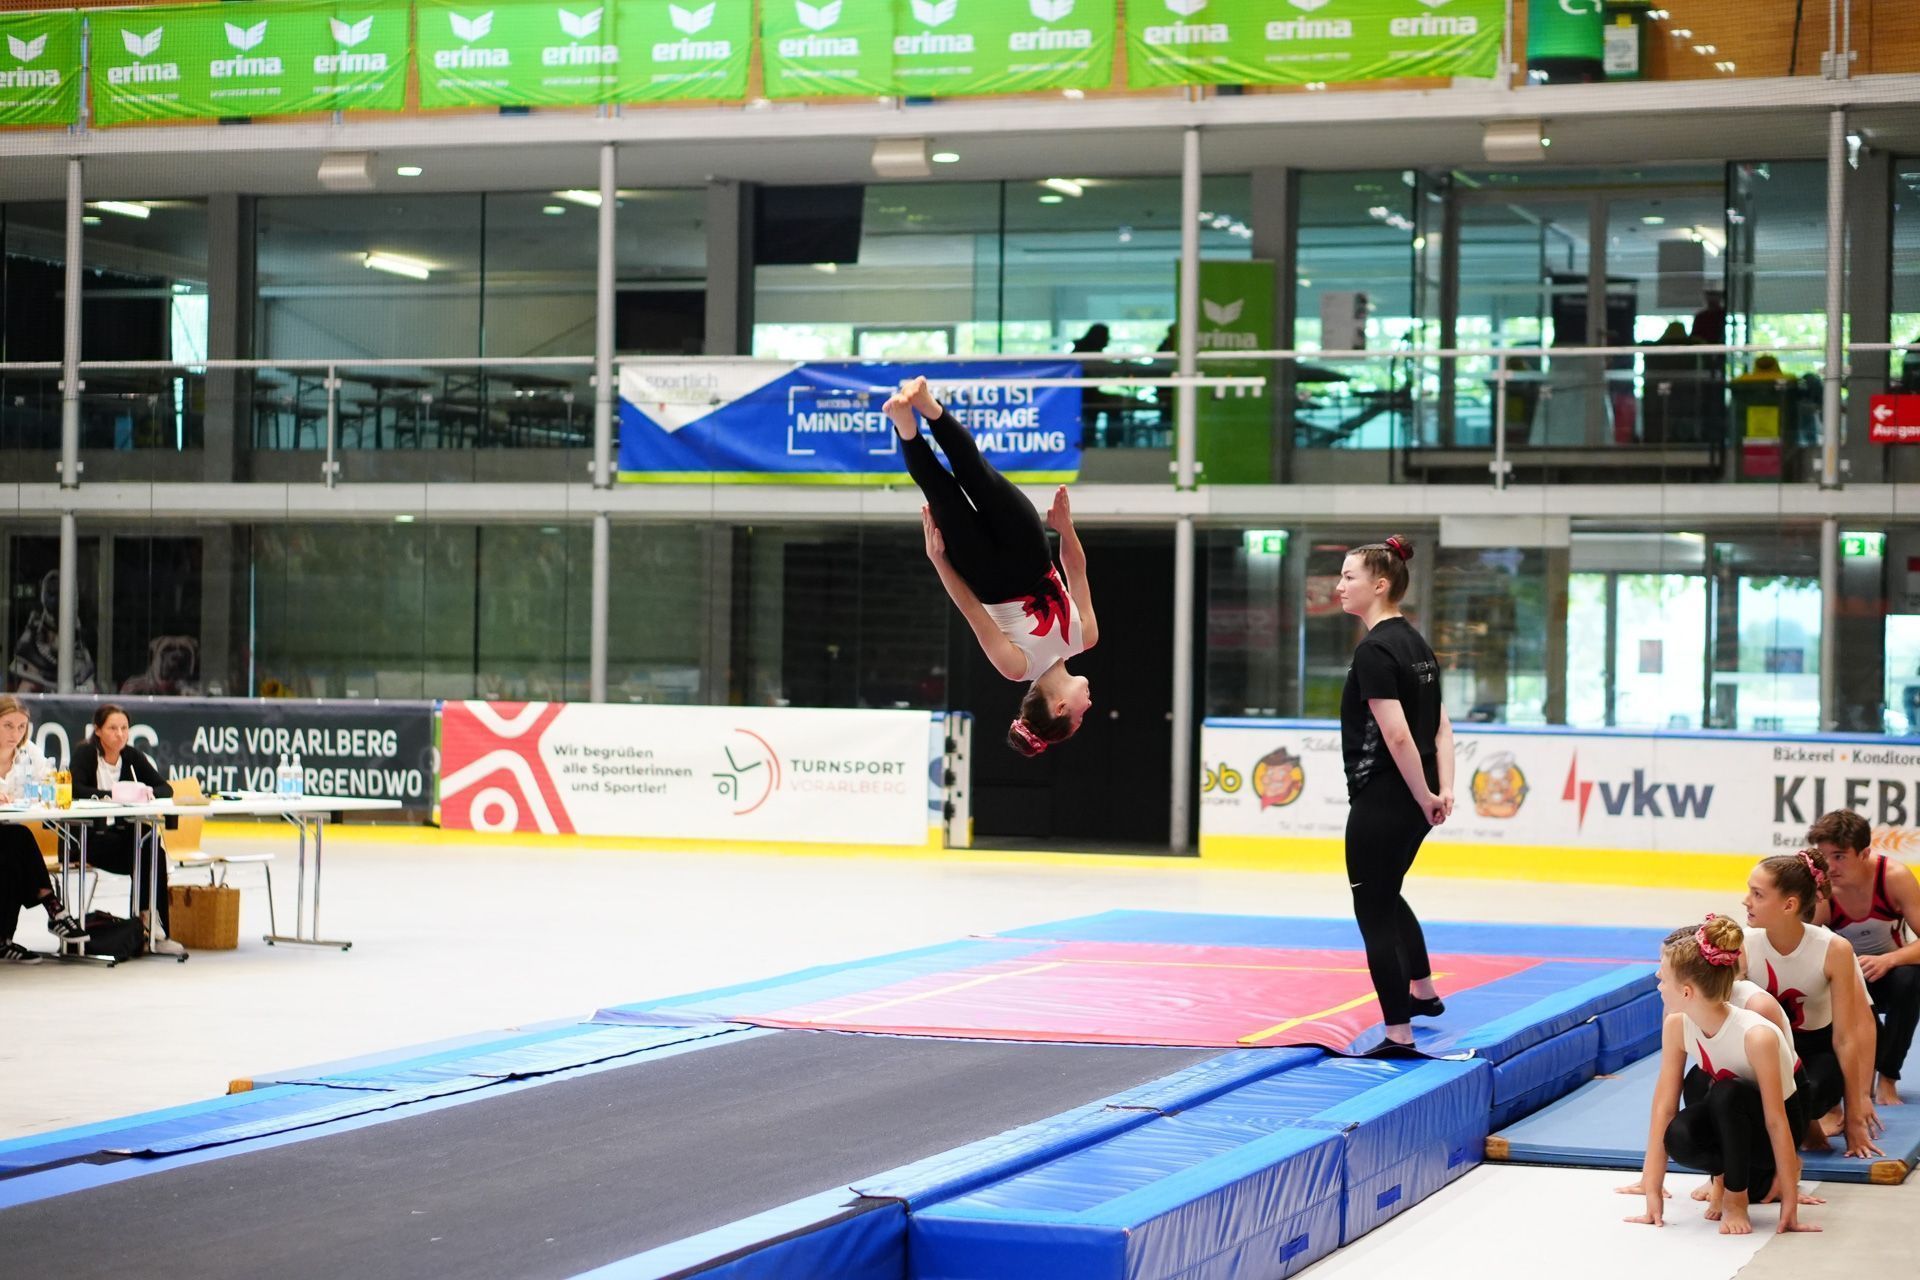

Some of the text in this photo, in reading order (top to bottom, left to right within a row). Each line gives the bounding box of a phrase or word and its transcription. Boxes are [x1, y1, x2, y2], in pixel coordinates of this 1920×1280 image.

[1144, 20, 1229, 45] erima
[1265, 15, 1353, 41] erima
[1390, 12, 1477, 37] erima
[652, 38, 732, 62] erima
[779, 35, 858, 58] erima
[894, 31, 974, 55] erima
[1009, 27, 1092, 51] erima
[210, 54, 282, 78] erima
[313, 50, 388, 74] erima
[434, 45, 509, 69] erima
[542, 42, 619, 66] erima
[108, 61, 178, 84] erima
[972, 407, 1040, 430] FRAGE
[192, 726, 239, 754] AUS
[245, 727, 398, 758] VORARLBERG
[553, 744, 654, 759] Wir begrüßen
[1773, 747, 1835, 761] Bäckerei
[563, 763, 693, 777] alle Sportlerinnen
[791, 759, 906, 775] TURNSPORT
[244, 766, 277, 793] VO
[304, 767, 423, 797] RGENDWO
[571, 781, 667, 794] und Sportler!
[790, 779, 907, 794] VORARLBERG
[1598, 768, 1715, 819] vkw
